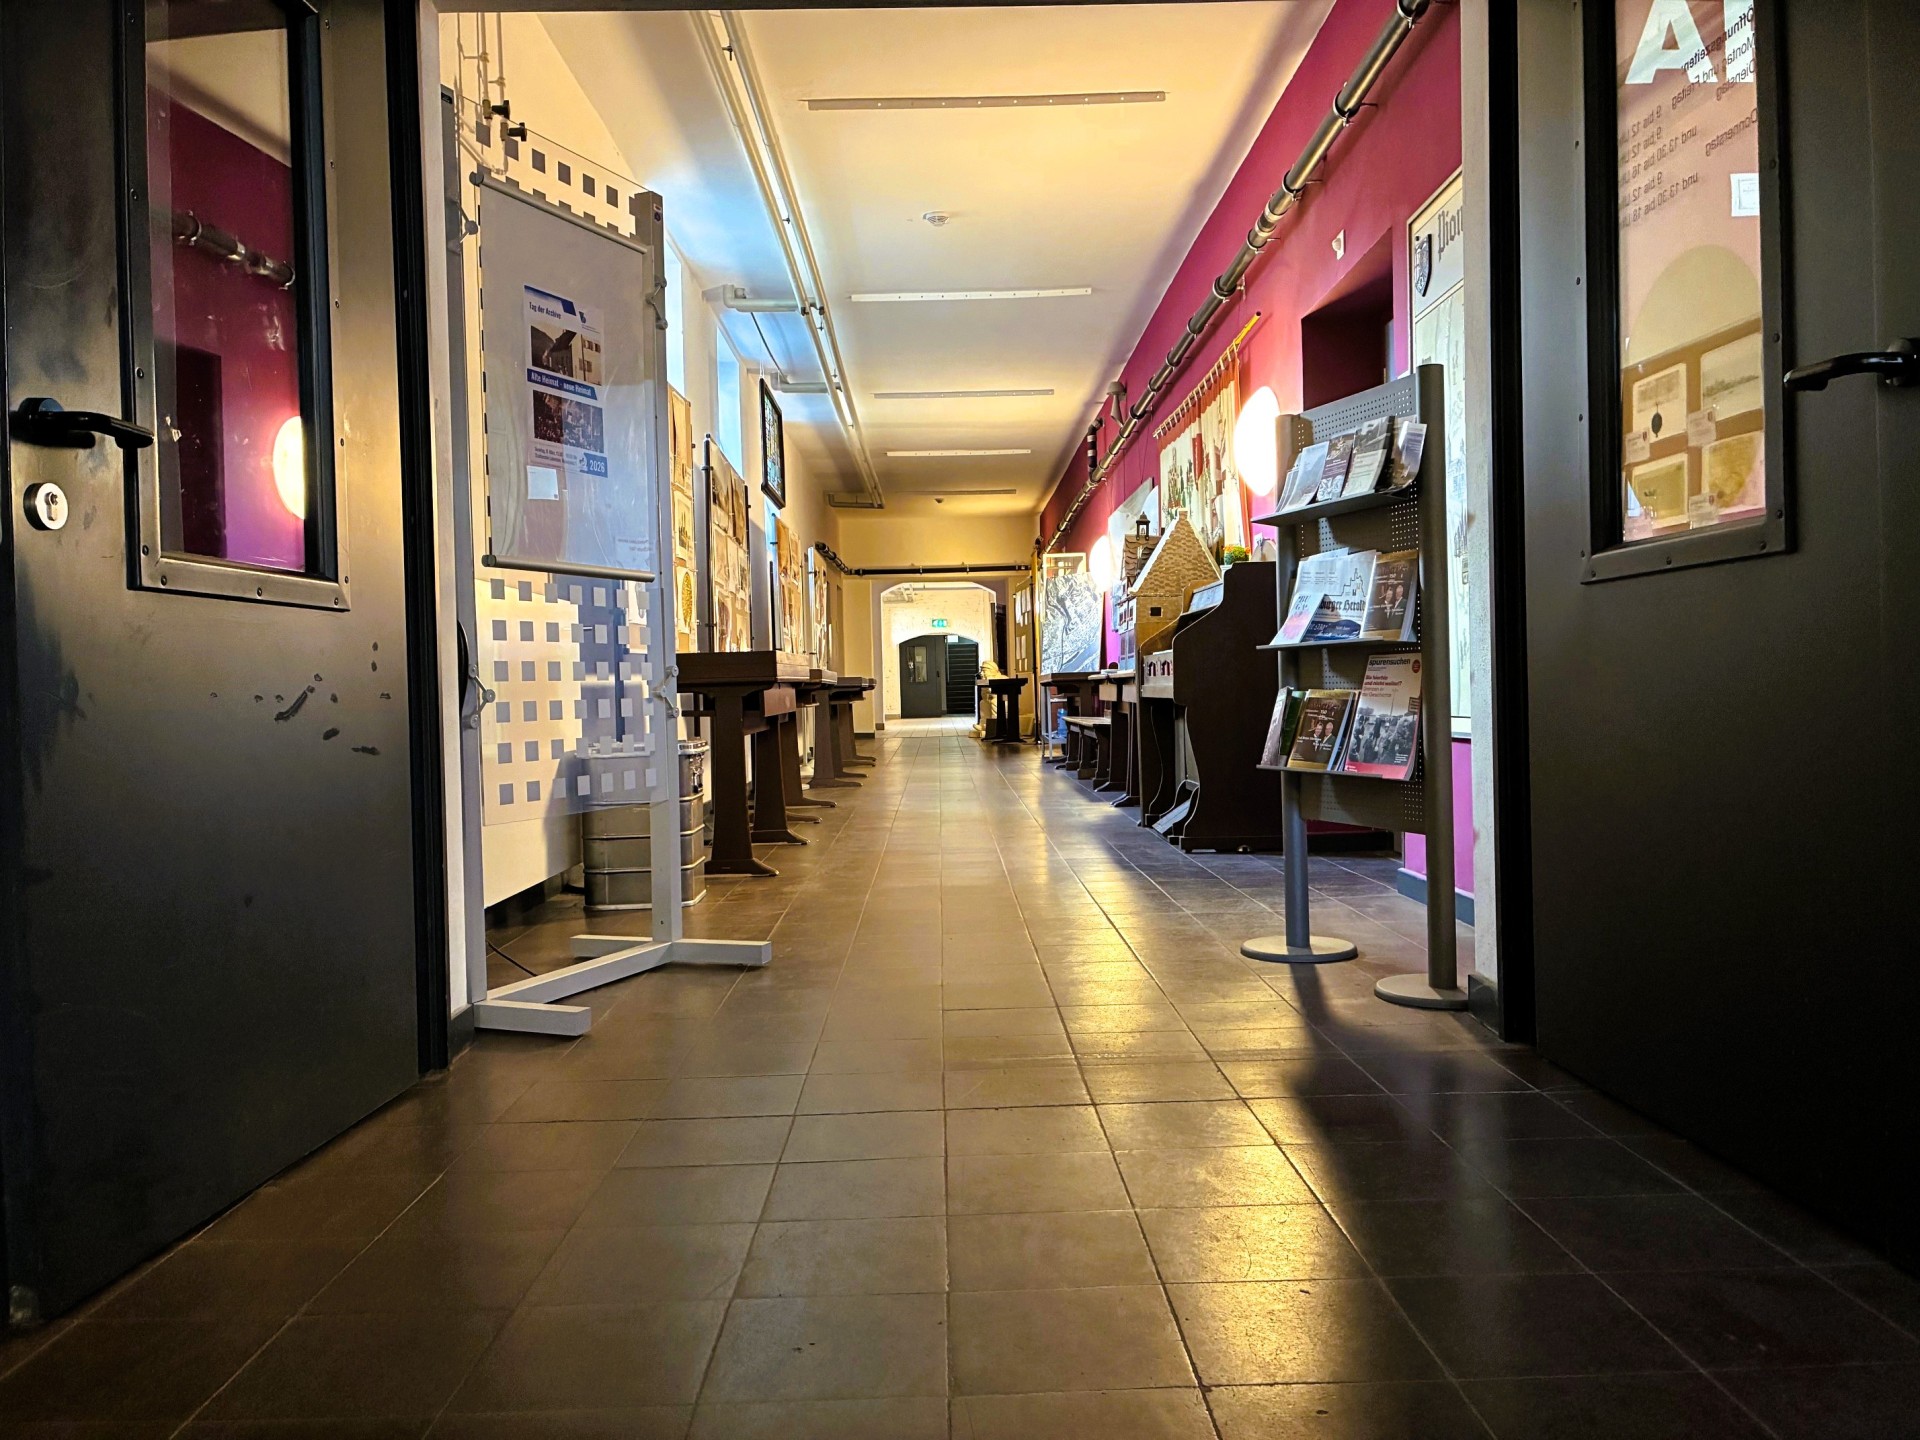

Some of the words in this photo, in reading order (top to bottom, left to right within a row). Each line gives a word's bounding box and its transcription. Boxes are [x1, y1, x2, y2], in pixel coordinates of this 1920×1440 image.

[529, 301, 537, 313] Tag
[537, 305, 545, 314] der
[545, 307, 562, 320] Archive
[590, 460, 605, 473] 2026
[1368, 657, 1411, 667] spurensuchen
